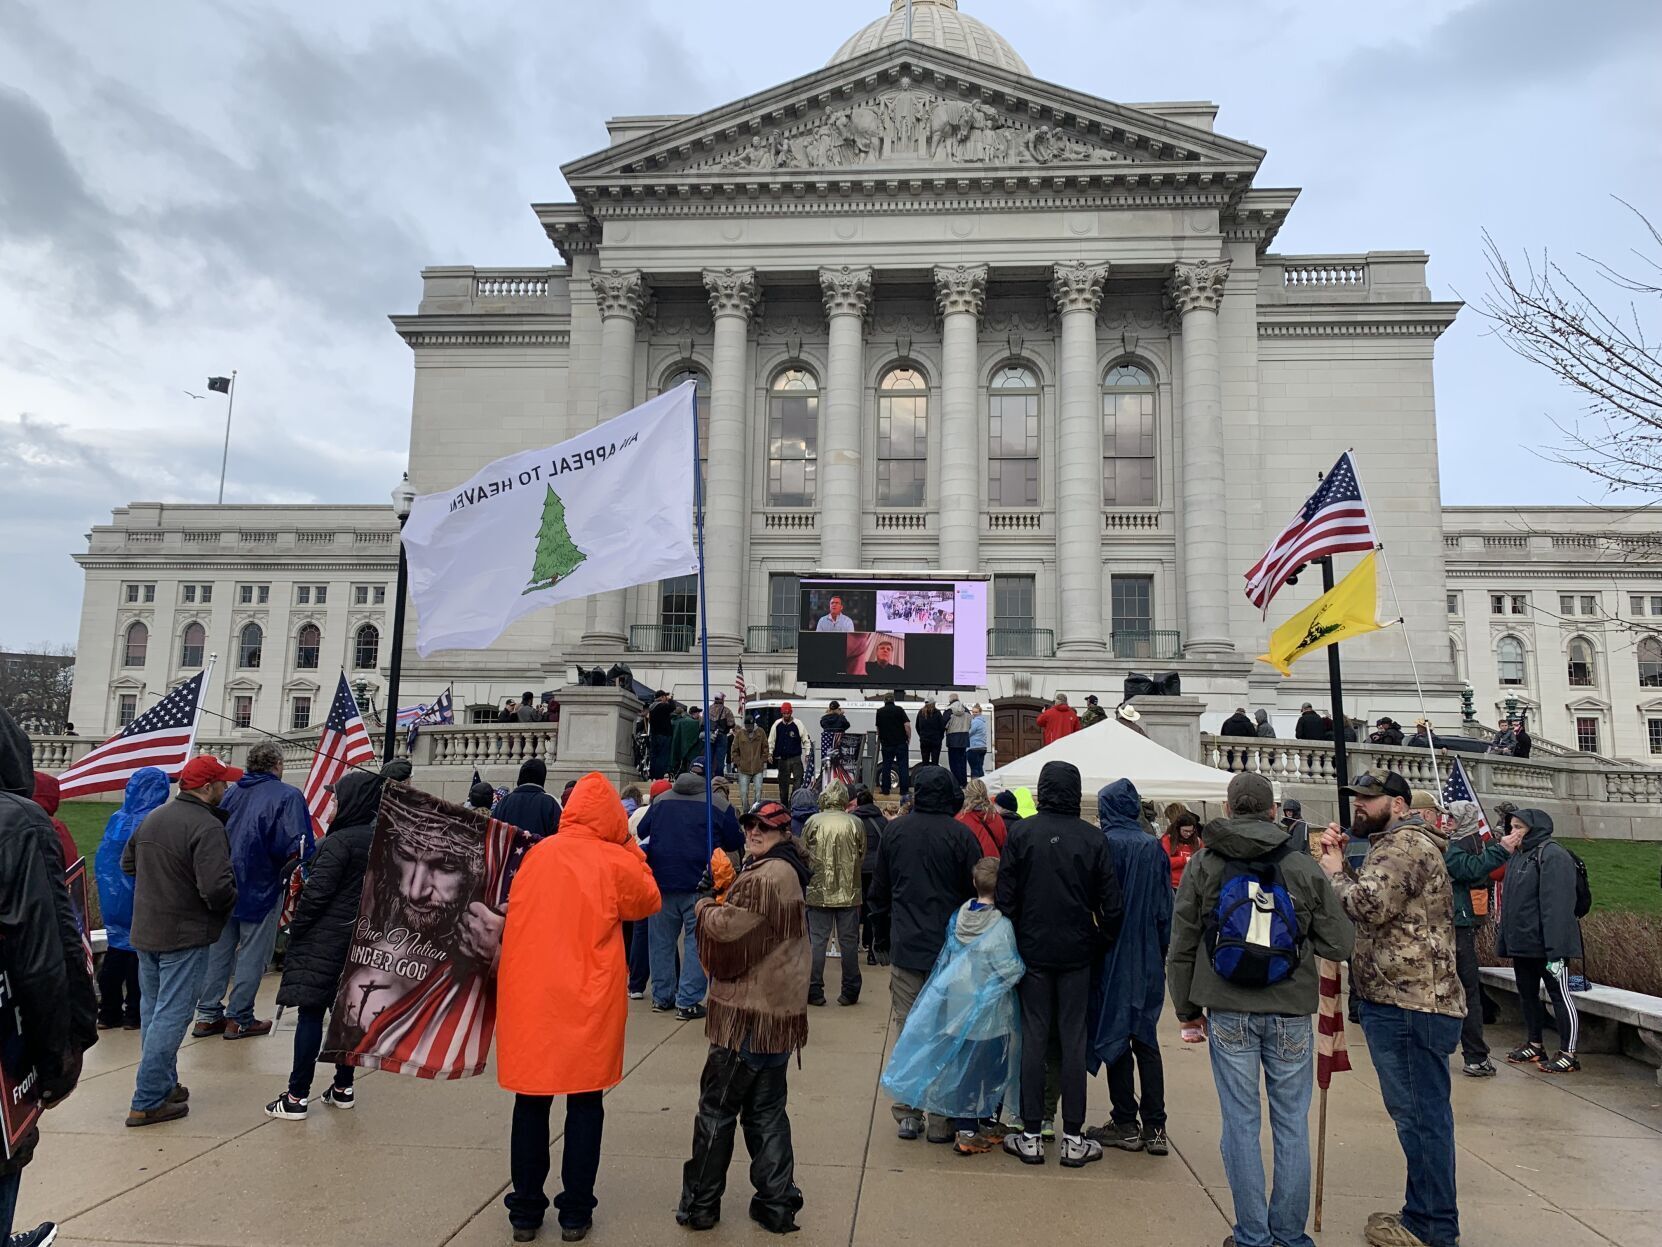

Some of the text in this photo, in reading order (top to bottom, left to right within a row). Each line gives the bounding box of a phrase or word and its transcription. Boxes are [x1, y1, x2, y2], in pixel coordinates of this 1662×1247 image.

[356, 915, 448, 962] One Nation
[350, 944, 428, 981] UNDER GOD
